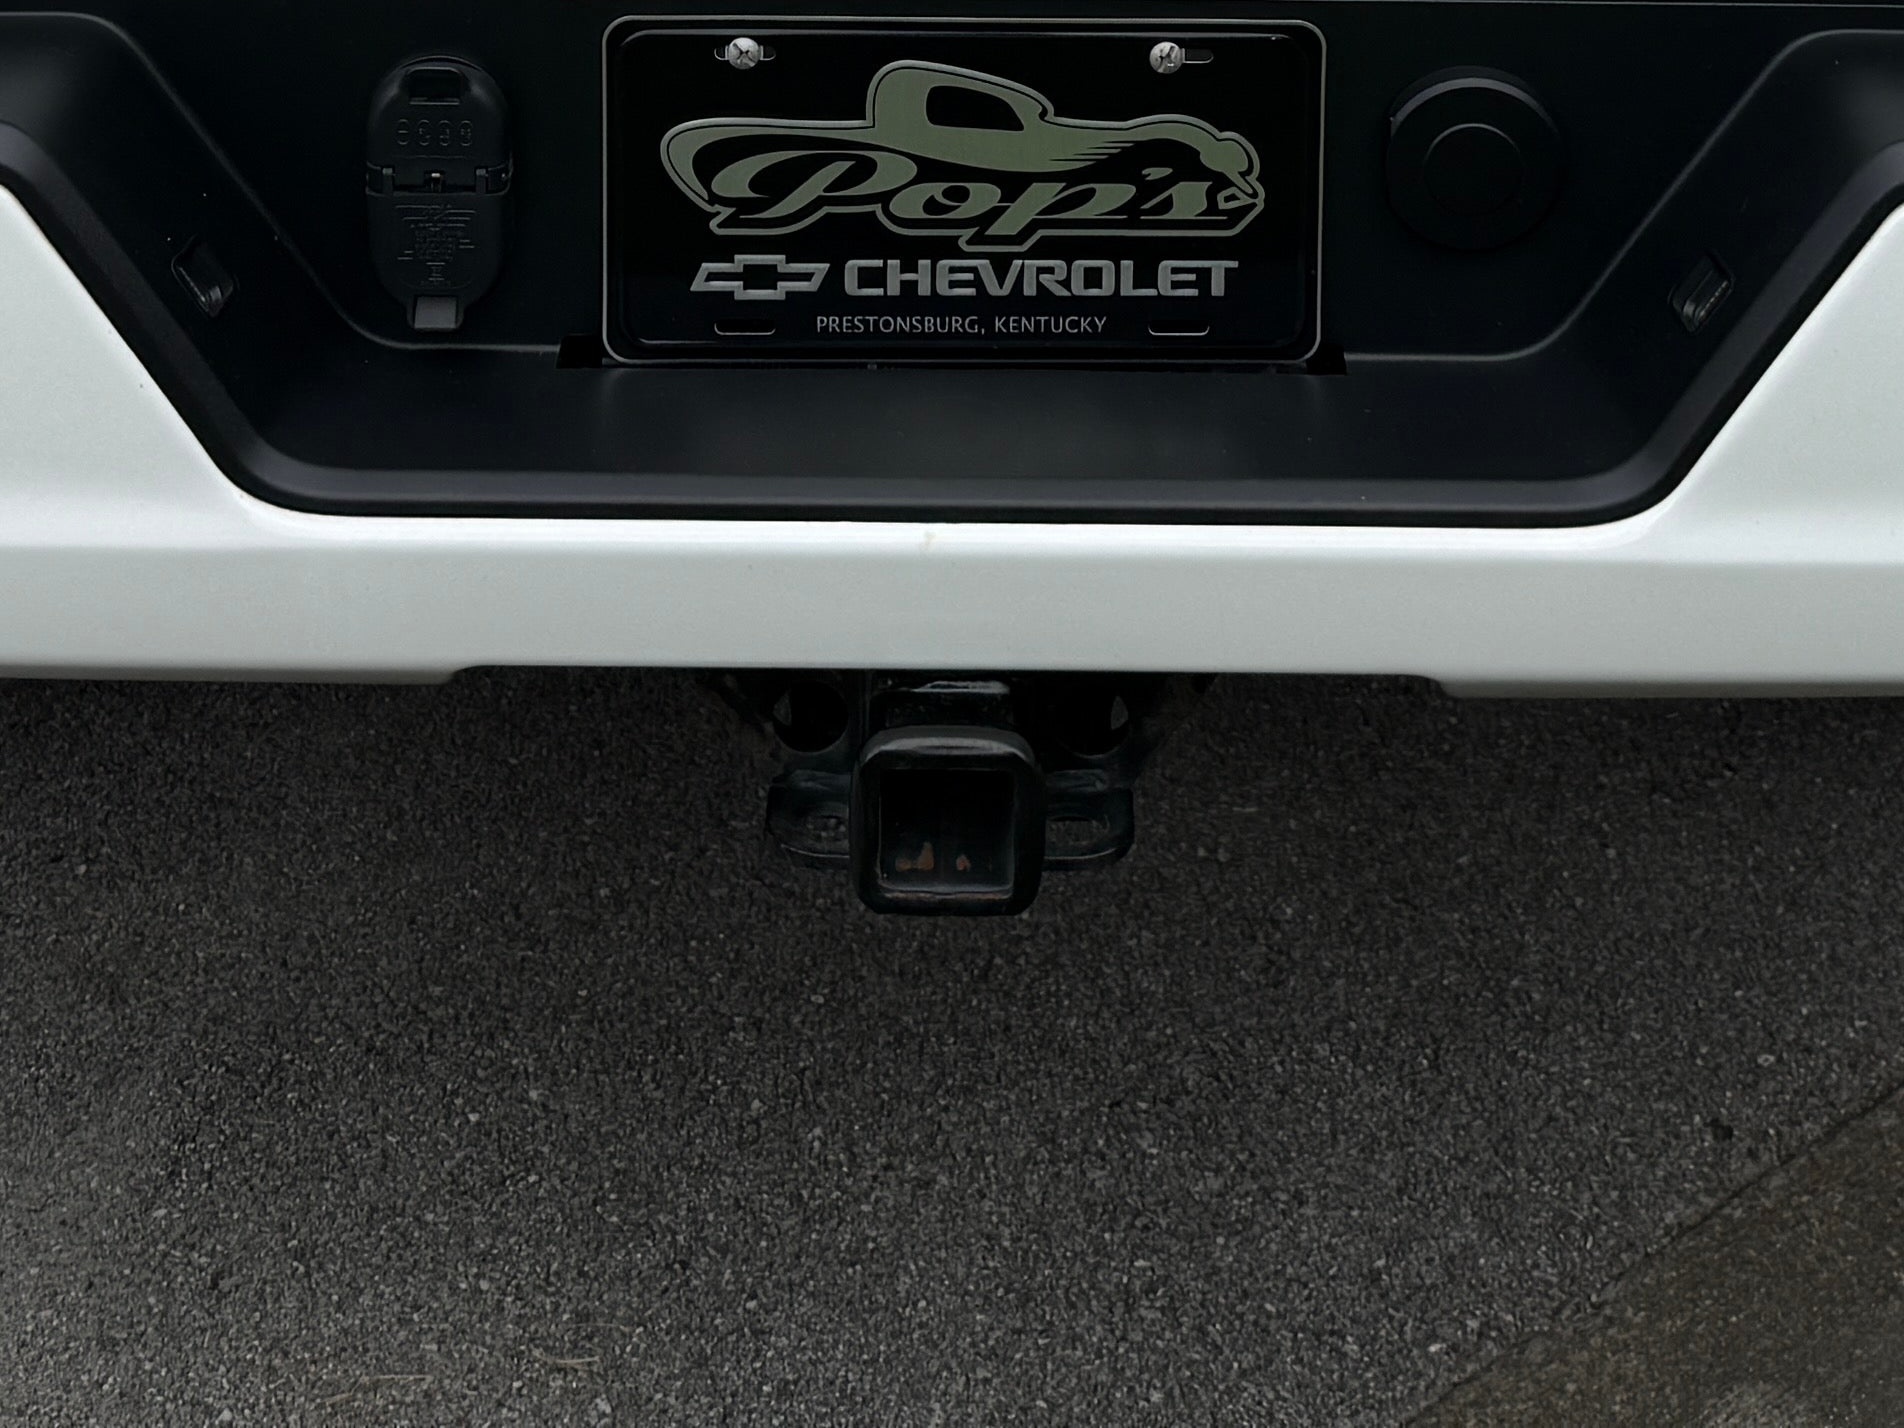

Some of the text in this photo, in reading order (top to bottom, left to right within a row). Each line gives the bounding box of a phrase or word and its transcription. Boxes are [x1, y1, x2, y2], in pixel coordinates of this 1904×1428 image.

[710, 149, 1229, 235] Pop's
[844, 258, 1240, 297] CHEVROLET
[816, 315, 1108, 336] PRESTONSBURG, KENTUCKY
